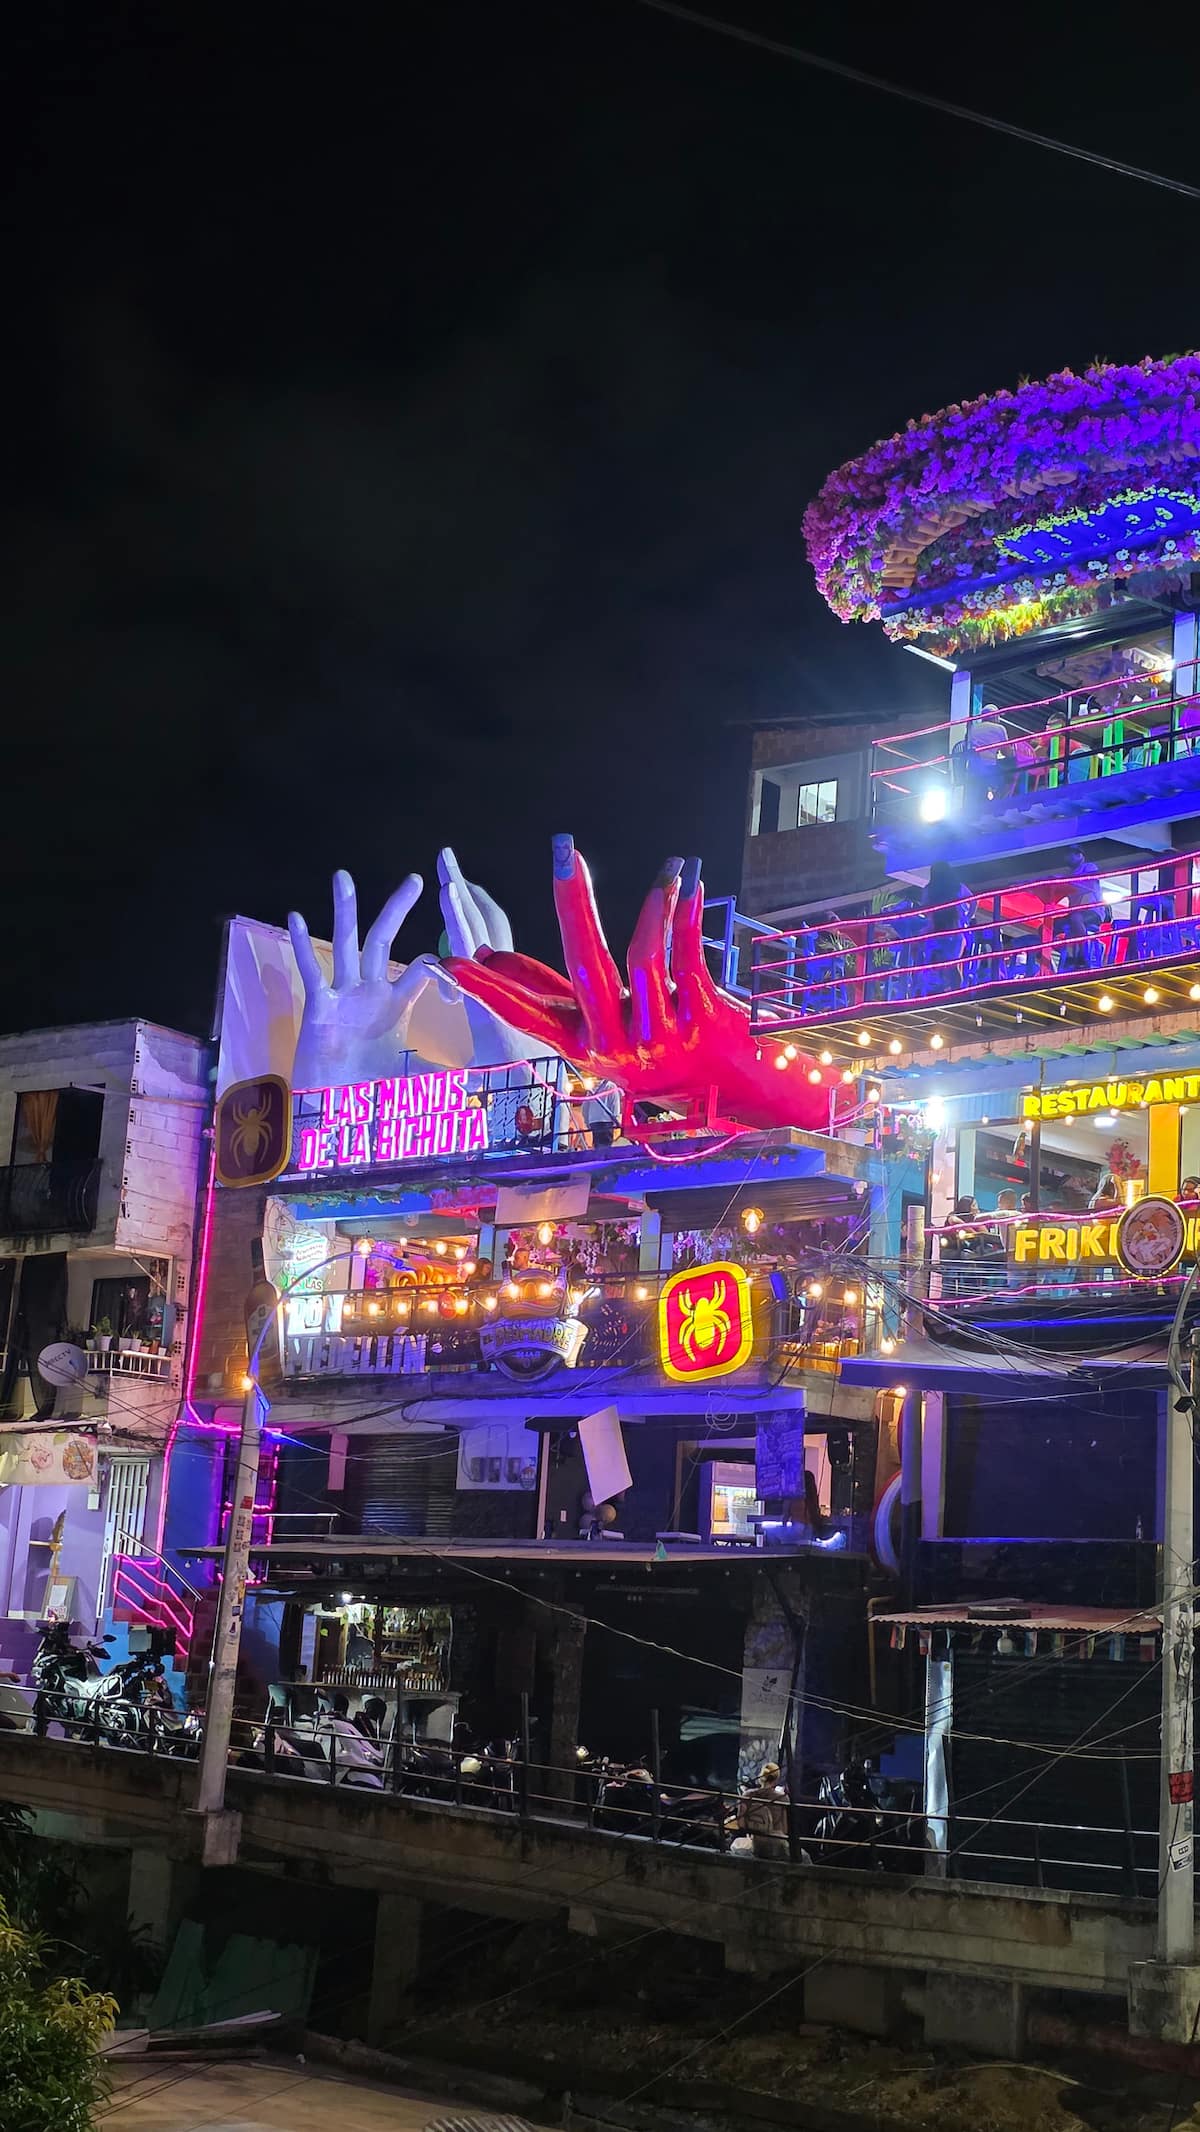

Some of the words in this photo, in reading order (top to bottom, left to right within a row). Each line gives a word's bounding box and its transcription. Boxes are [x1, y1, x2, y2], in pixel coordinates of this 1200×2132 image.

[323, 1081, 374, 1127] LAS
[378, 1069, 468, 1120] MANOS
[298, 1128, 335, 1170] DE
[337, 1124, 371, 1165] LA
